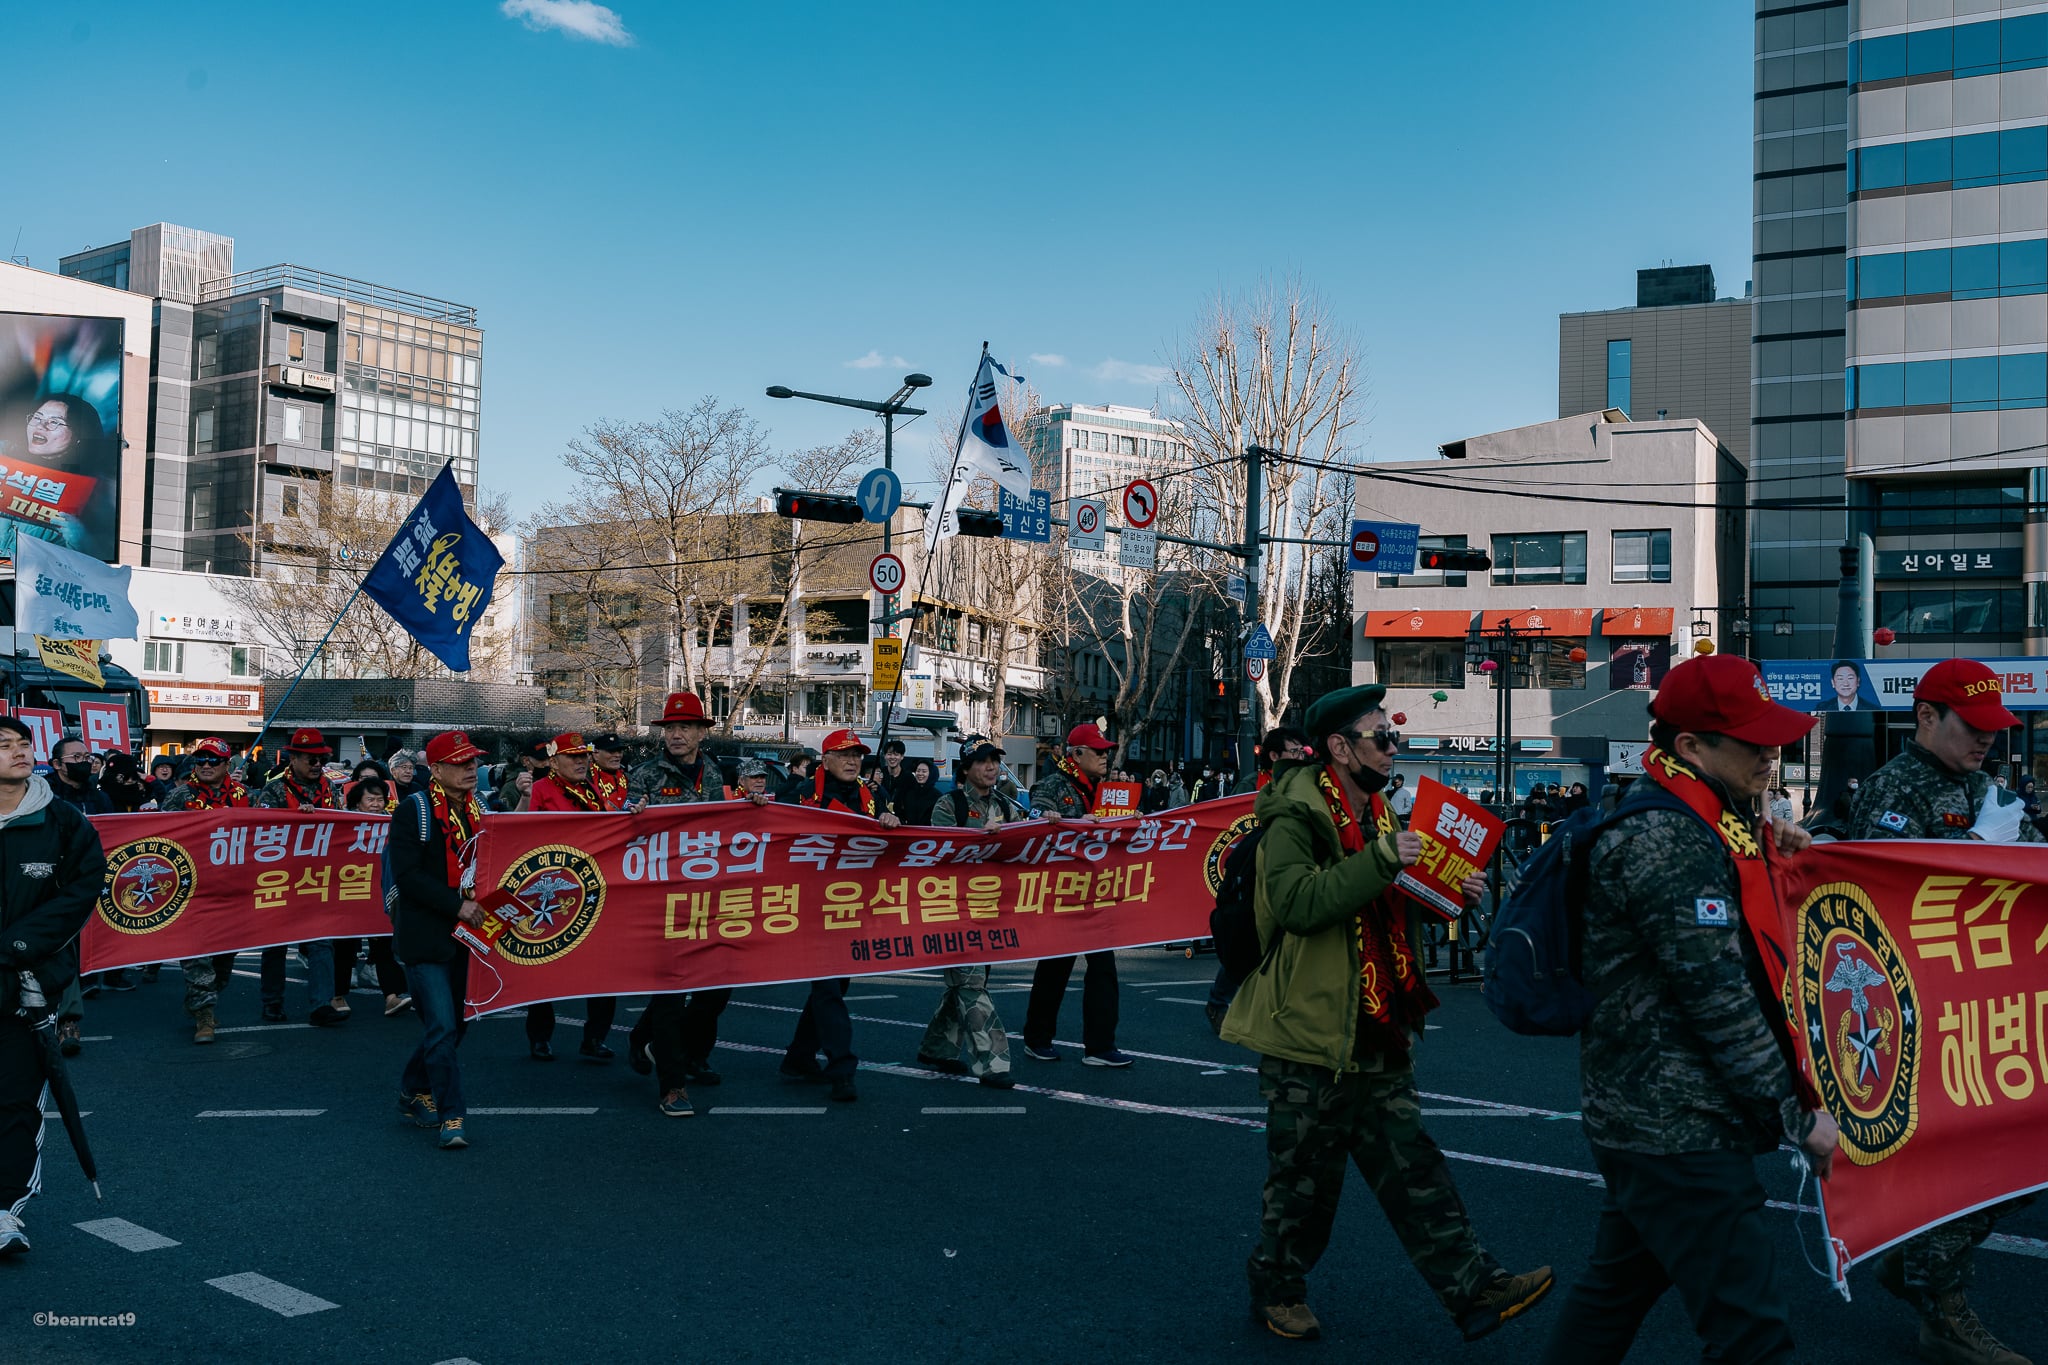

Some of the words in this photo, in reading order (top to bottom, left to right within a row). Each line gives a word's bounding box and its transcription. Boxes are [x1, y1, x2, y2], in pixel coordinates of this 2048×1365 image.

[1080, 512, 1094, 527] 40
[877, 565, 898, 583] 50
[1901, 553, 1993, 572] 신아일보
[876, 661, 899, 671] 단속중
[1250, 659, 1261, 674] 50
[1767, 682, 1821, 700] 곽상언
[209, 824, 330, 866] 해병대
[1435, 802, 1488, 857] 윤석열
[622, 832, 771, 882] 해병의
[788, 834, 889, 871] 죽음
[253, 863, 372, 910] 윤석열
[664, 884, 799, 941] 대통령
[822, 876, 1002, 931] 윤석열을
[1013, 861, 1155, 915] 파면한다
[121, 913, 163, 928] MARINE
[162, 888, 187, 917] CORPS
[1909, 875, 2033, 972] 특검
[515, 939, 562, 955] MARINE
[563, 905, 593, 942] CORPS
[850, 935, 914, 962] 해병대
[922, 931, 984, 956] 예비역
[988, 928, 1020, 949] 연대
[1847, 1115, 1904, 1146] MARINE
[1891, 1031, 1914, 1119] CORPS
